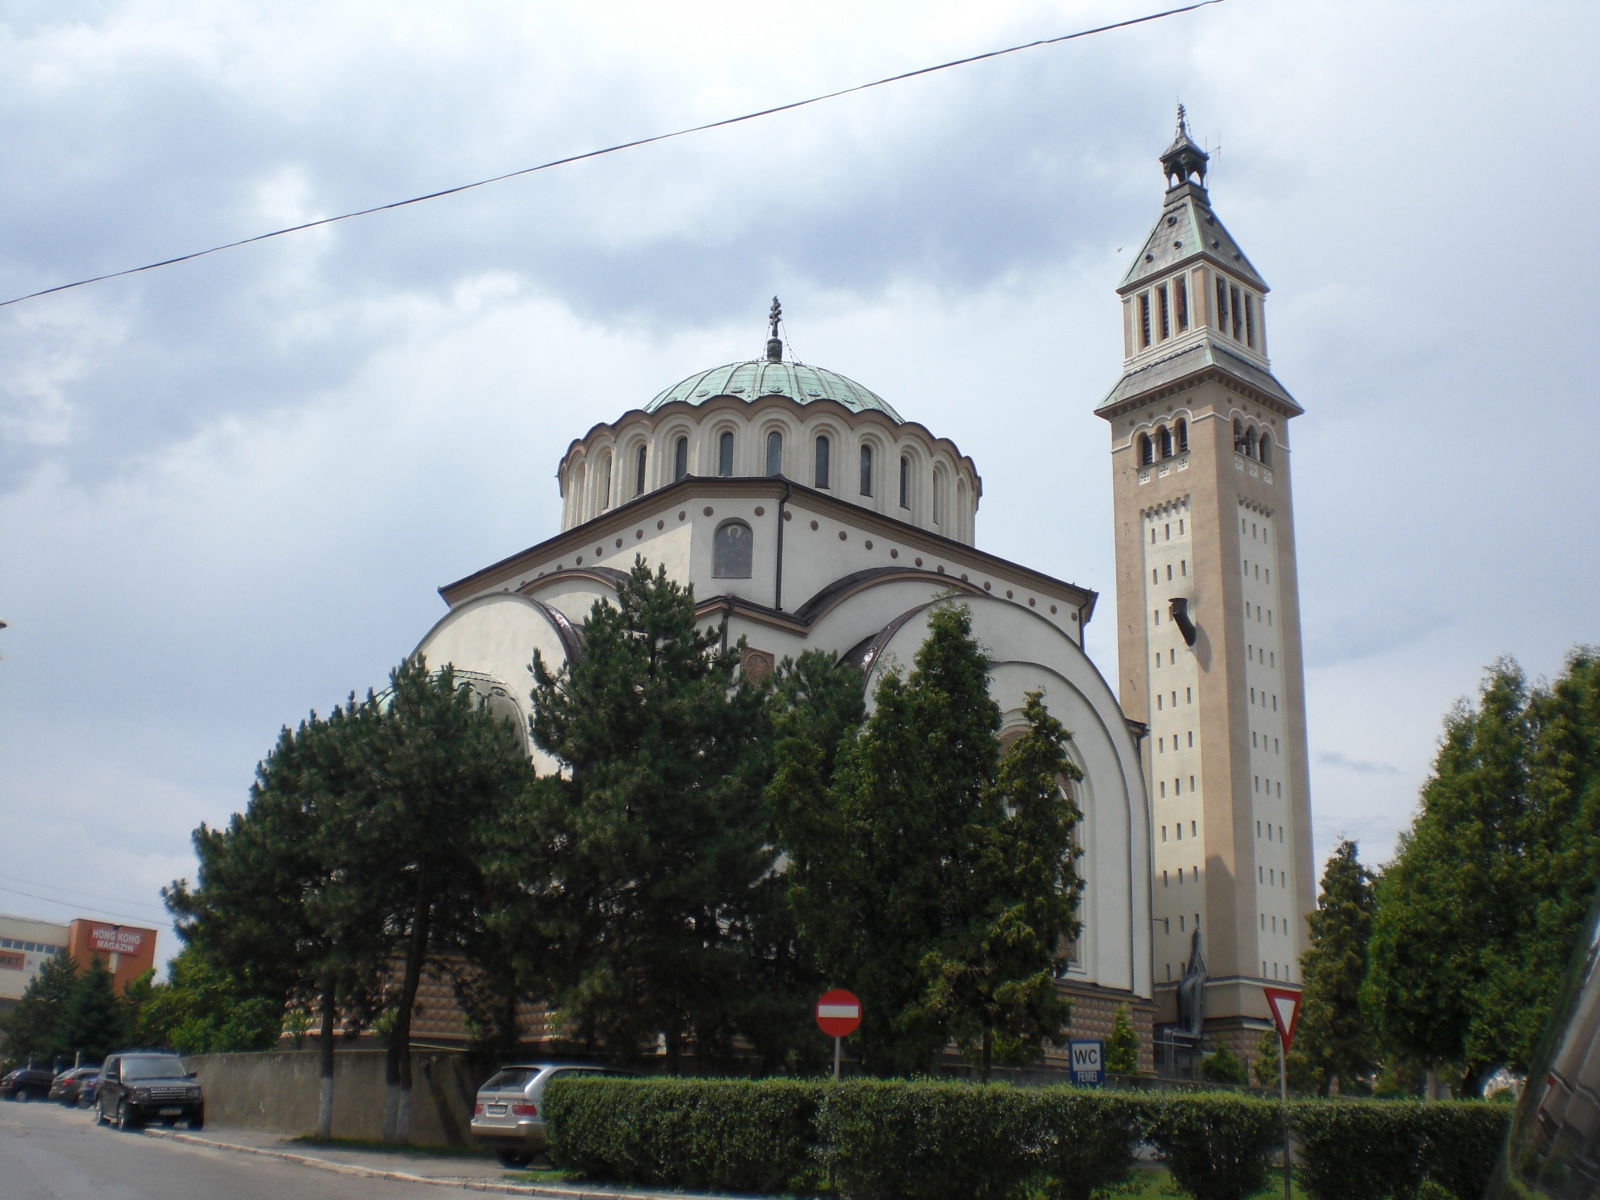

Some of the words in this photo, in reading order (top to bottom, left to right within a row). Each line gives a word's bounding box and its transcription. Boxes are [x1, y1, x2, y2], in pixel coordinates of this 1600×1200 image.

[92, 928, 116, 940] HONG
[117, 932, 140, 945] KONG
[96, 940, 134, 952] MAGAZIN
[1074, 1049, 1098, 1065] WC
[1077, 1071, 1098, 1082] FEMEI
